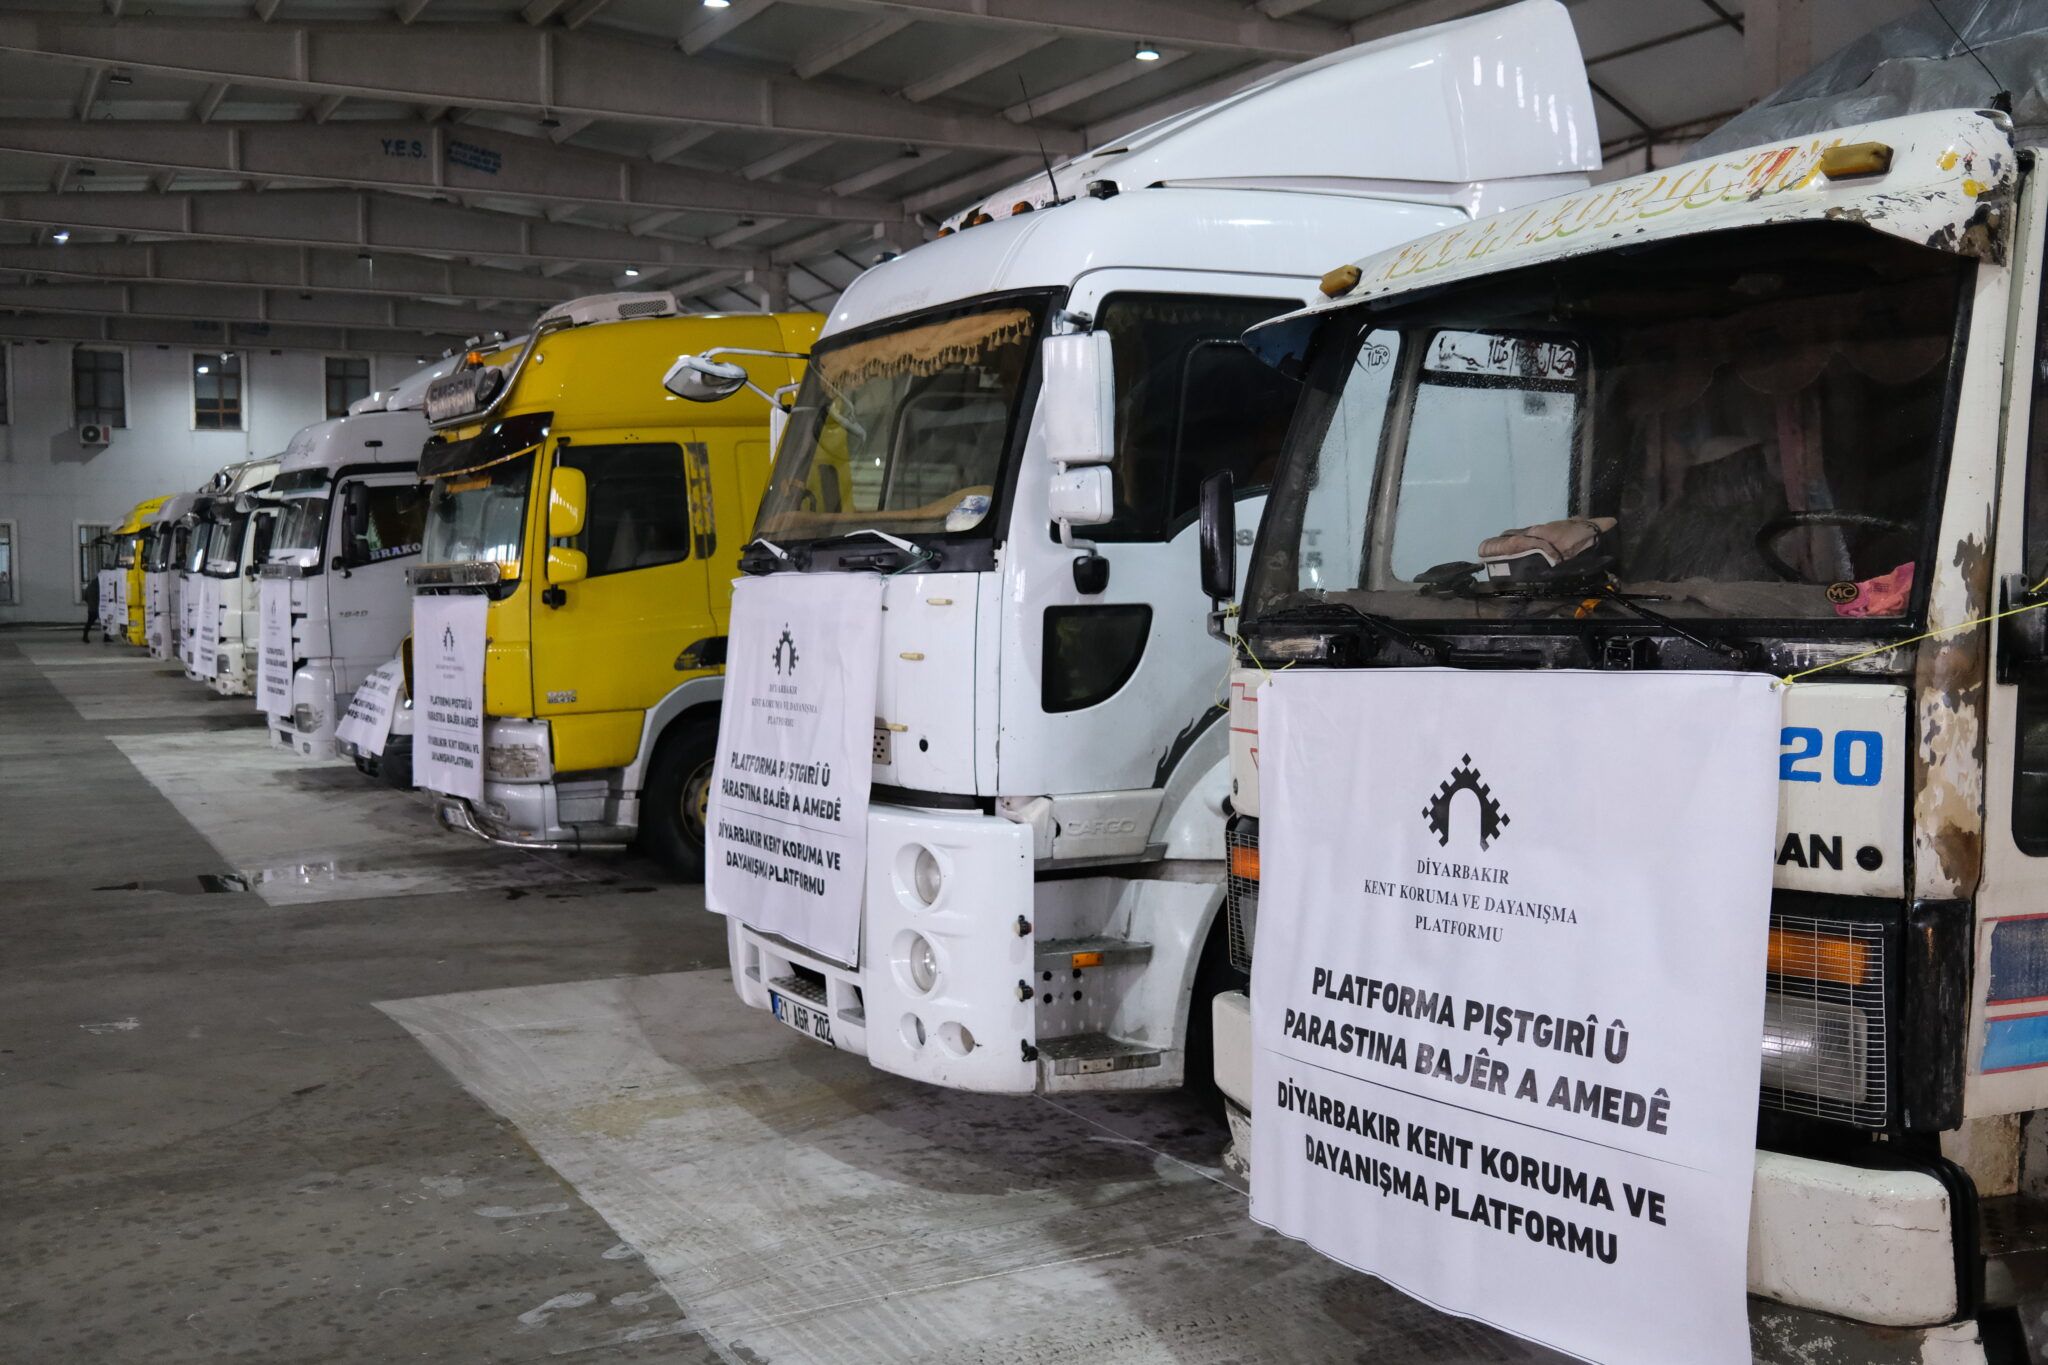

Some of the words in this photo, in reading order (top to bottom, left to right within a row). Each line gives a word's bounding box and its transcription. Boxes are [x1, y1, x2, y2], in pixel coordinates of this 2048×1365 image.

[381, 139, 427, 159] Y.E.S.
[731, 752, 777, 777] PLATFORMA
[822, 763, 830, 787] Û
[1779, 727, 1884, 787] 20
[723, 779, 761, 803] PARASTINA
[763, 787, 790, 810] BAJÊR
[793, 795, 800, 812] A
[803, 797, 841, 821] AMEDÊ
[719, 819, 762, 848] DİYARBAKIR
[764, 834, 781, 854] KENT
[783, 840, 823, 866] KORUMA
[826, 851, 840, 870] VE
[1067, 820, 1136, 836] CARGO
[727, 851, 768, 878] DAYANIŞMA
[769, 865, 824, 896] PLATFORMU
[1418, 858, 1508, 884] DİYARBAKIR
[1774, 833, 1843, 871] AN
[1365, 880, 1395, 896] KENT
[1400, 885, 1457, 906] KORUMA
[1463, 894, 1479, 909] VE
[1485, 897, 1576, 923] DAYANIŞMA
[1416, 915, 1502, 942] PLATFORMU
[1312, 967, 1454, 1027] PLATFORMA
[1464, 1000, 1598, 1058] PIŞTGIRÎ
[1605, 1019, 1628, 1064] Û
[1284, 1008, 1407, 1069] PARASTINA
[1415, 1043, 1509, 1095] BAJÊR
[1515, 1069, 1538, 1103] A
[1547, 1076, 1670, 1135] AMEDÊ
[1278, 1079, 1400, 1147] DİYARBAKIR
[1407, 1123, 1473, 1169] KENT
[1481, 1145, 1614, 1211] KORUMA
[1623, 1183, 1666, 1226] VE
[1306, 1135, 1428, 1206] DAYANIŞMA
[1435, 1182, 1617, 1264] PLATFORMU
